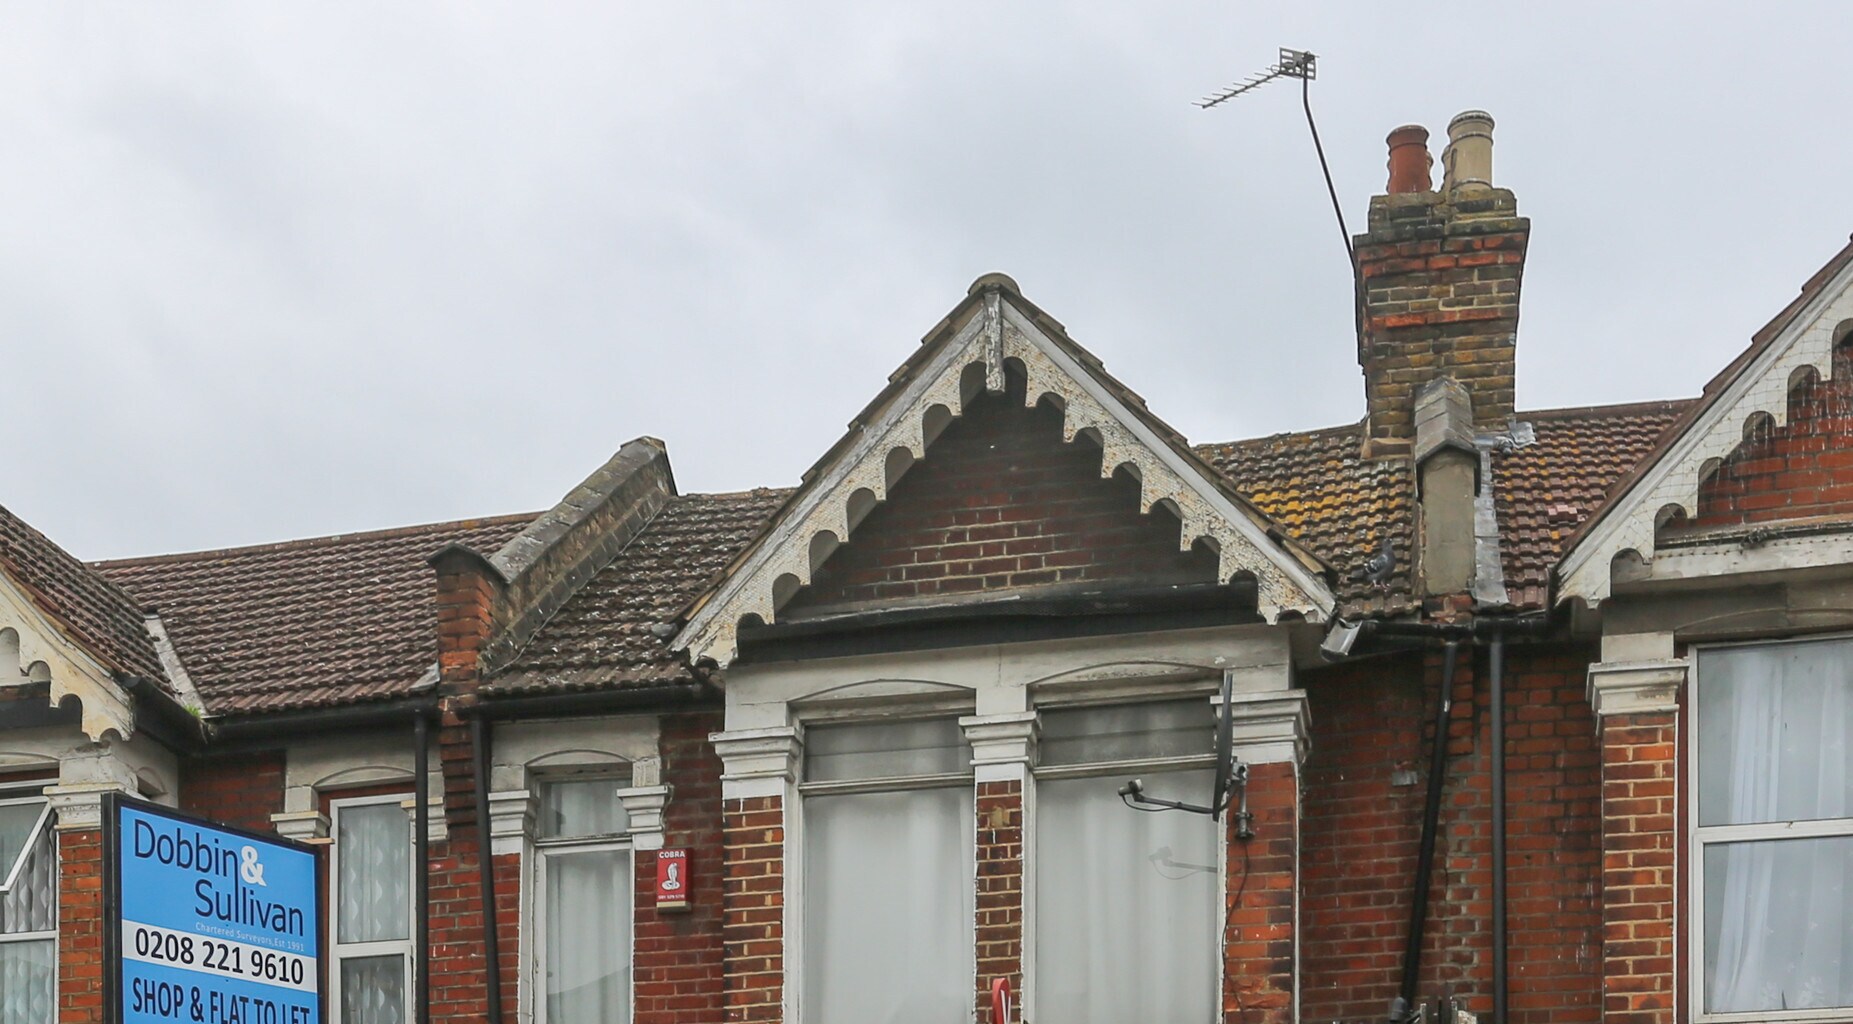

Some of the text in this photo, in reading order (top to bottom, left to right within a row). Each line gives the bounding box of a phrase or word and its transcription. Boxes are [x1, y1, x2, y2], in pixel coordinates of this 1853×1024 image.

[134, 818, 266, 887] Dobbin &
[658, 850, 686, 859] COBRA
[194, 879, 303, 937] Sullivan
[195, 921, 235, 939] Chartered
[135, 927, 304, 985] 0208 221 9610
[132, 976, 184, 1020] SHOP
[190, 985, 205, 1023] &
